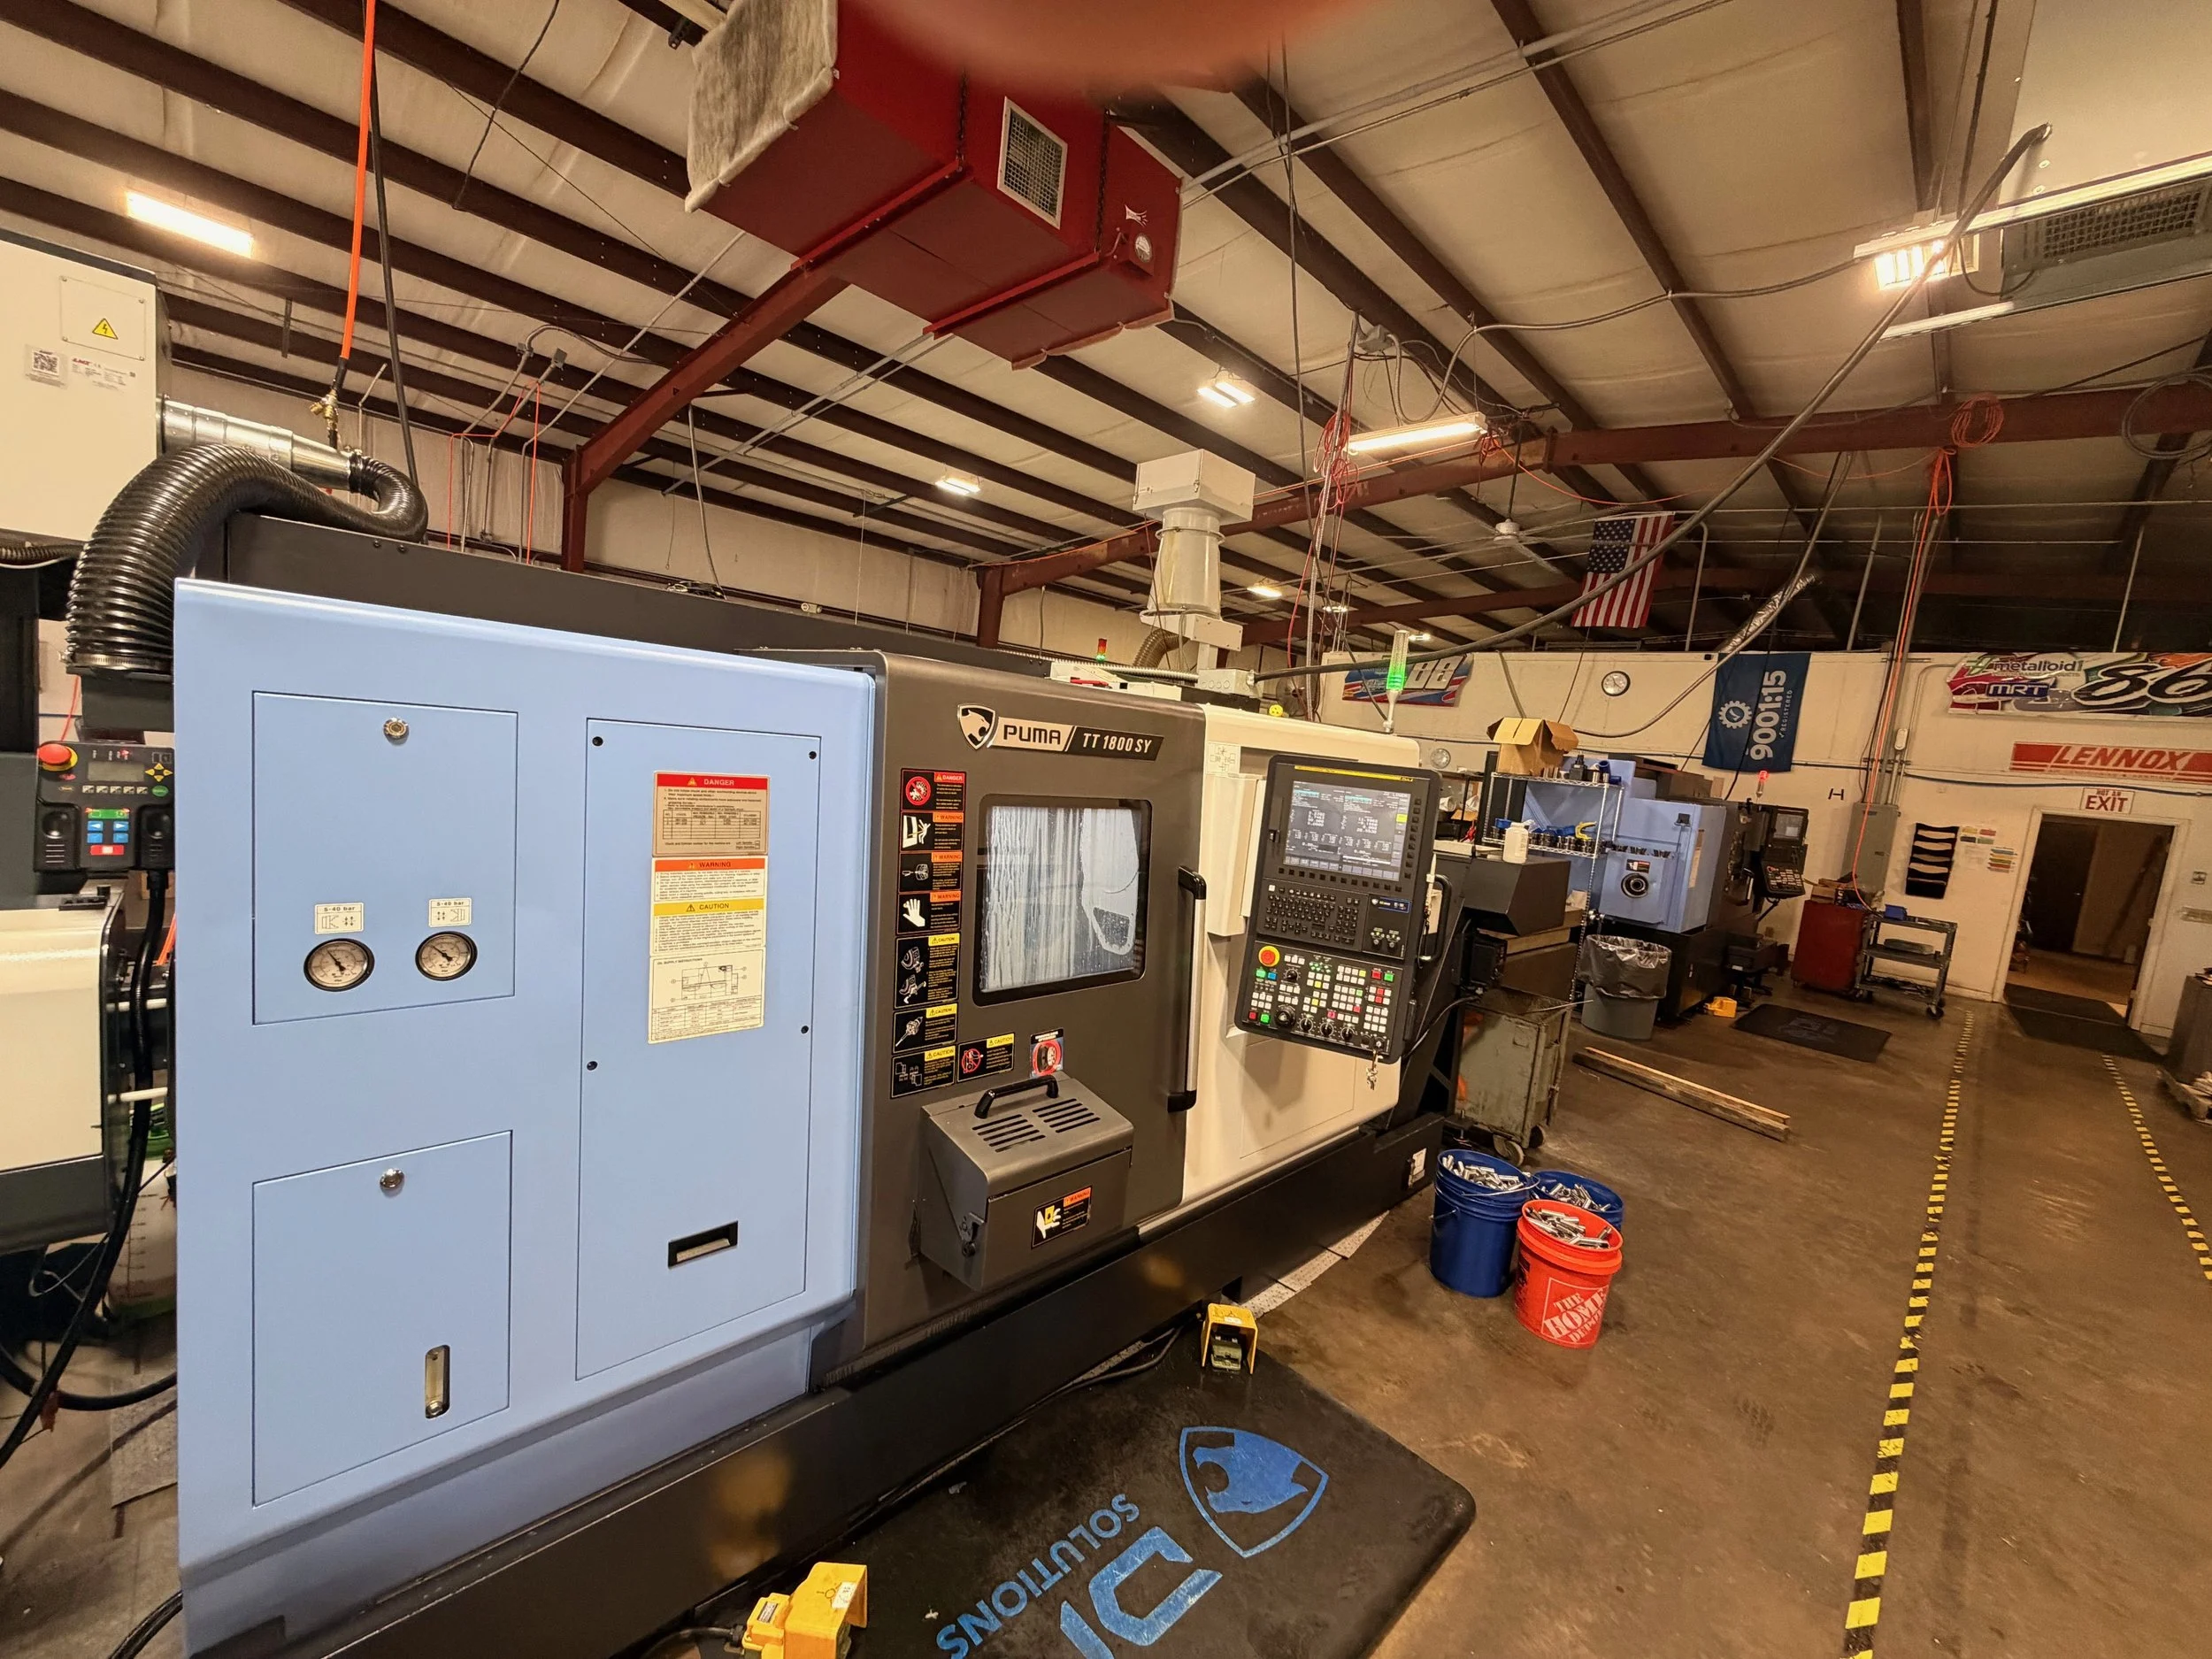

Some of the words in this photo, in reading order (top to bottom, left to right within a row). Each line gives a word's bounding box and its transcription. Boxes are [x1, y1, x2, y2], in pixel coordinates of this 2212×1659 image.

[1403, 656, 1466, 690] 88
[1749, 670, 1787, 761] 9001:15
[1002, 724, 1062, 745] PUMA
[1082, 733, 1103, 749] TT
[1102, 735, 1133, 752] 1800
[1134, 738, 1153, 754] SY
[2052, 745, 2193, 772] LENNOX
[703, 778, 734, 787] DANGER
[2085, 795, 2129, 813] EXIT
[699, 902, 730, 911] CAUTION
[994, 1036, 1013, 1046] CAUTION
[933, 1048, 955, 1058] CAUTION
[1553, 1293, 1585, 1313] THE
[935, 1493, 1141, 1659] SOLUTIONS
